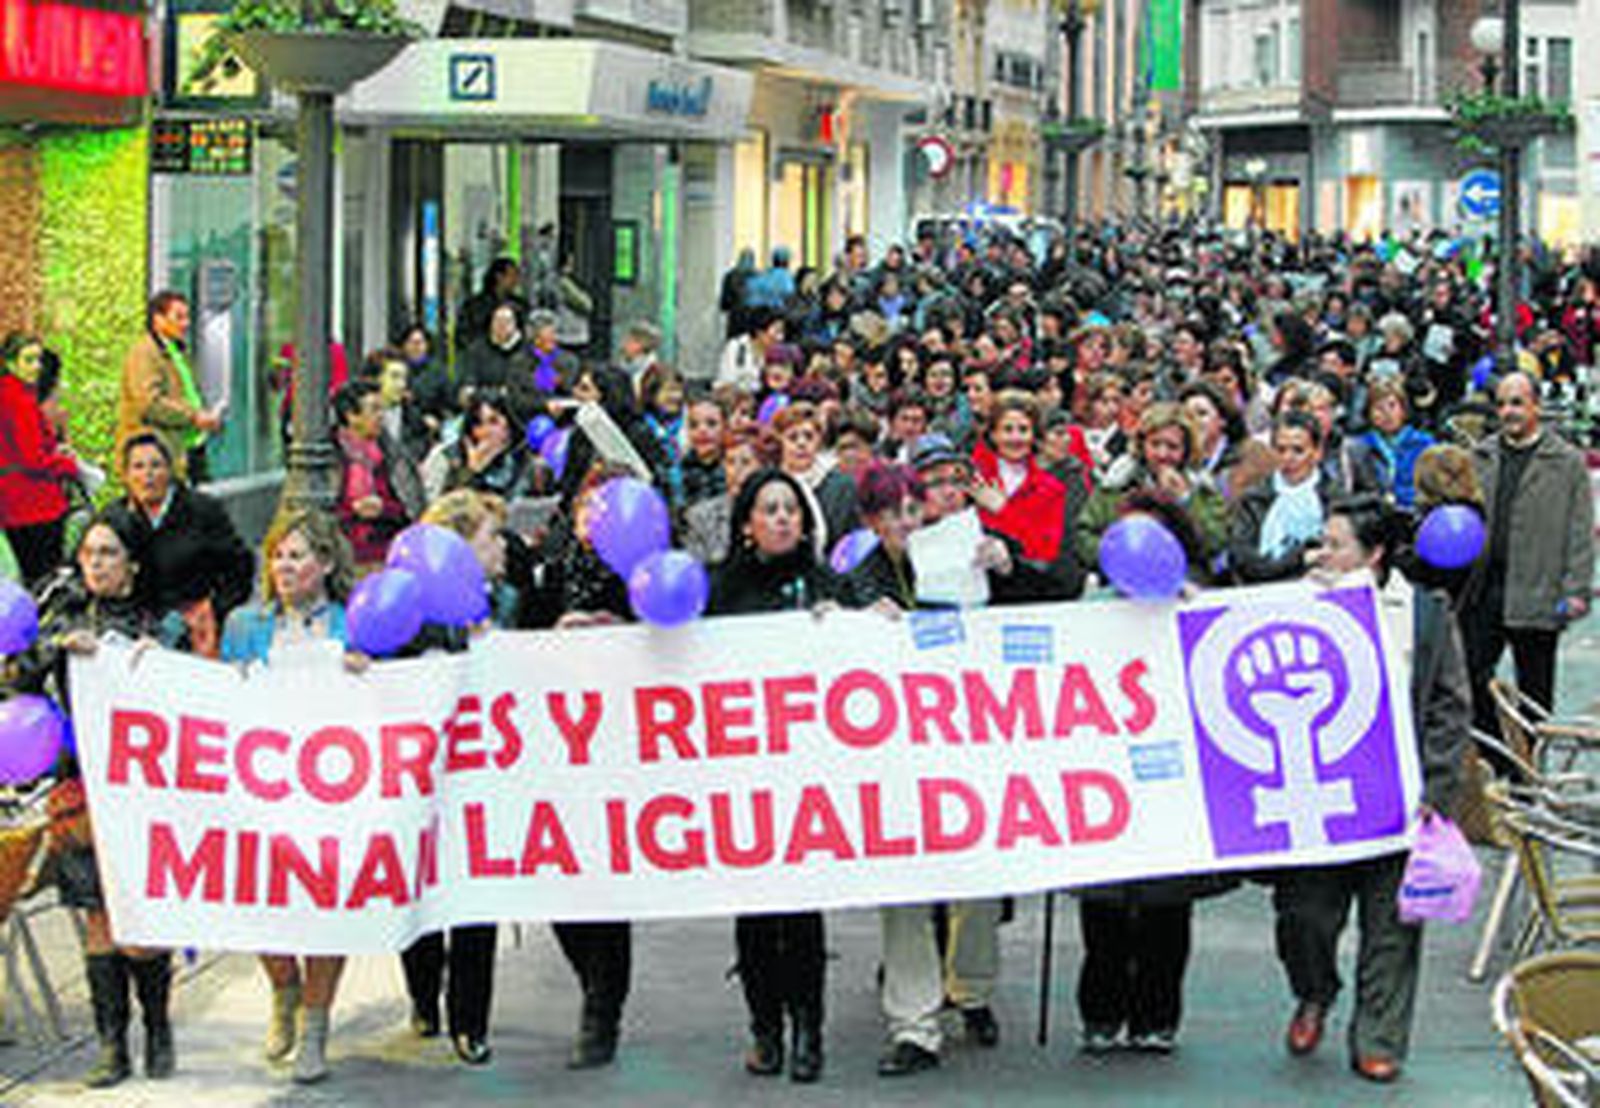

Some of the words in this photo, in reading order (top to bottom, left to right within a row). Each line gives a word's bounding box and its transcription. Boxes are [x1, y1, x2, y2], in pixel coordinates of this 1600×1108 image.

[107, 692, 525, 806] RECORES
[546, 688, 605, 767] Y
[634, 657, 1158, 766] REFORMAS
[464, 799, 582, 879] LA
[605, 769, 1133, 877] IGUALDAD
